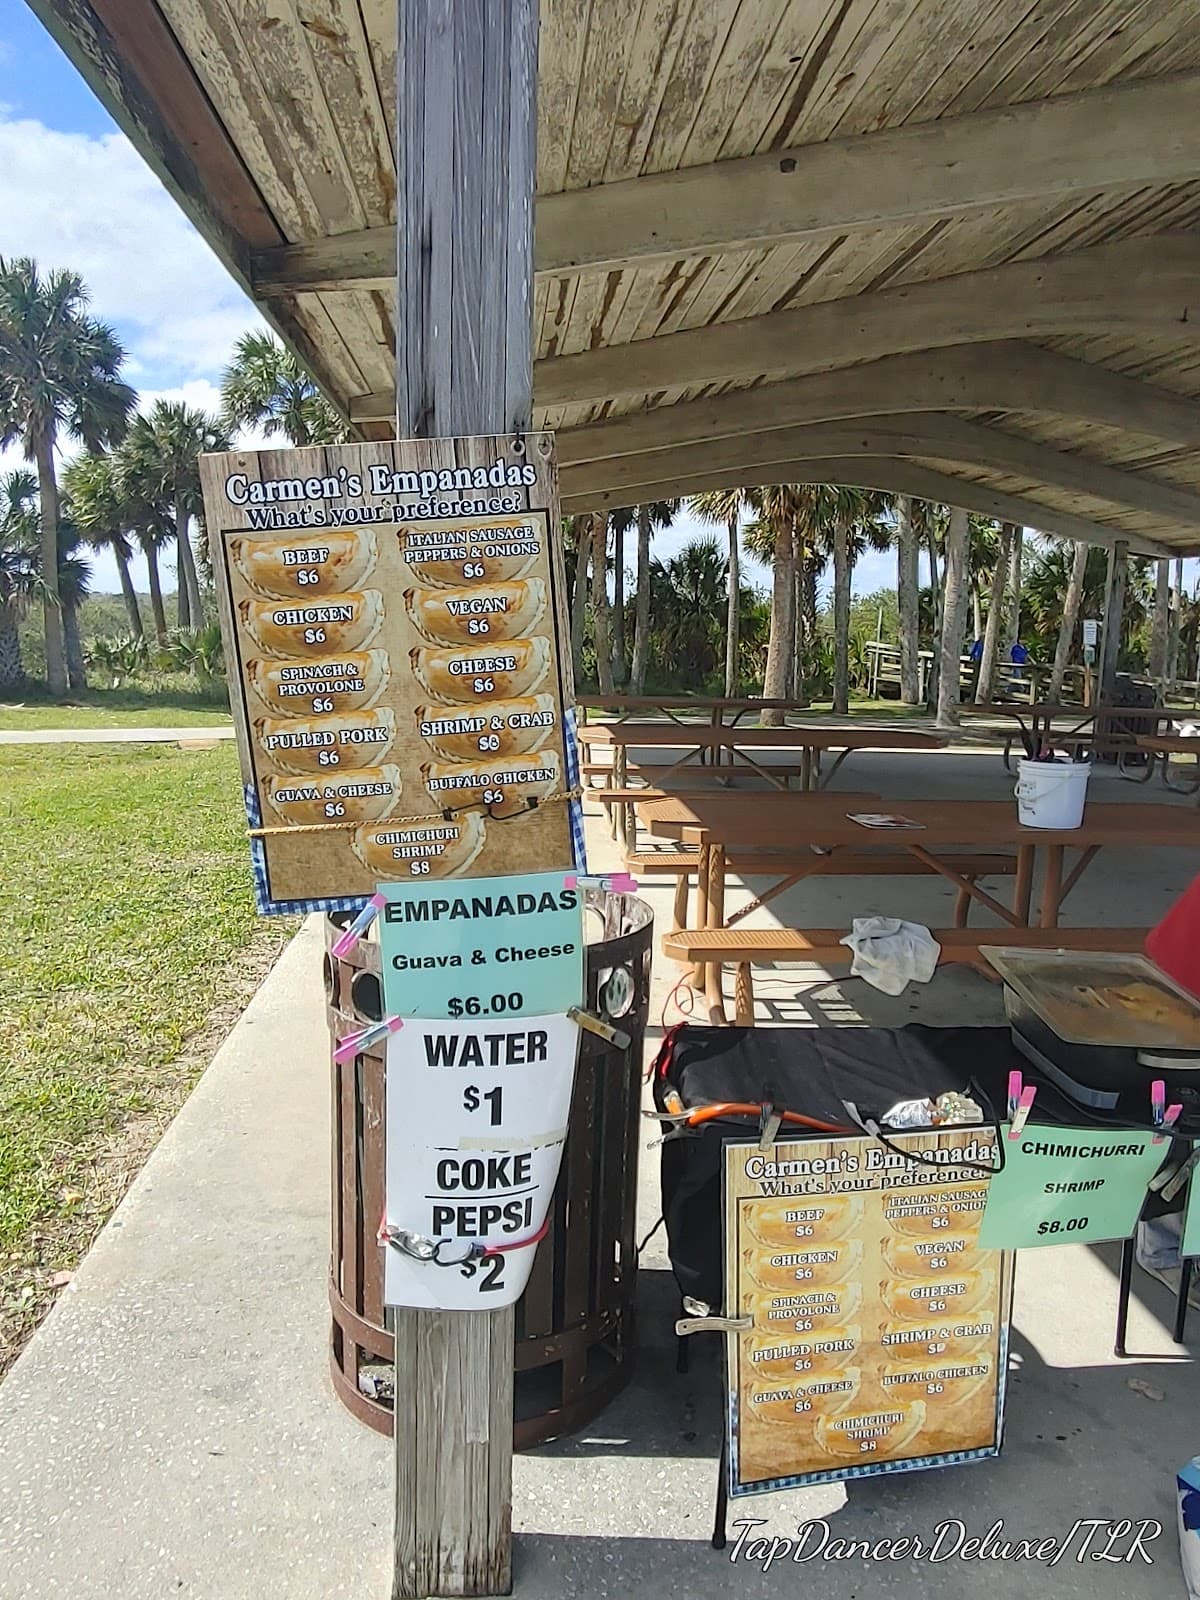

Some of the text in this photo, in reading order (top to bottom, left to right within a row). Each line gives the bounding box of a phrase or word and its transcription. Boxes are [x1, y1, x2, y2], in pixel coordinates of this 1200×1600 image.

[226, 458, 537, 506] Carmen's Empanadas
[245, 491, 522, 530] What's your preference?
[407, 526, 534, 547] ITALIAN SAUSAGE
[283, 549, 329, 566] BEEF
[404, 542, 539, 563] PEPPERS & ONIONS
[297, 570, 319, 586] $6
[463, 562, 484, 578] $6
[447, 597, 508, 615] VEGAN
[272, 606, 353, 626] CHICKEN
[468, 618, 489, 634] $6
[304, 628, 326, 644] $6
[281, 663, 358, 681] SPINACH &
[448, 657, 516, 675] CHEESE
[278, 678, 365, 696] PROVOLONE
[474, 678, 494, 693] $6
[312, 698, 333, 713] $6
[421, 711, 554, 736] SHRIMP & CRAB
[267, 727, 388, 750] PULLED PORK
[478, 735, 499, 751] $8
[318, 750, 340, 766] $6
[429, 768, 555, 791] BUFFALO CHICKEN
[275, 782, 392, 803] GUAVA & CHEESE
[483, 789, 504, 805] $6
[325, 802, 345, 817] $6
[376, 828, 459, 845] CHIMICHURI
[393, 844, 445, 859] SHRIMP
[410, 861, 430, 875] $8
[384, 890, 578, 923] EMPANADAS
[392, 944, 575, 970] Guava & Cheese
[448, 992, 523, 1017] $6.00
[423, 1030, 548, 1068] WATER
[463, 1086, 503, 1126] $1
[1021, 1141, 1145, 1159] CHIMICHURRI
[436, 1152, 531, 1191] COKE
[745, 1150, 858, 1180] Carmen's
[759, 1178, 824, 1197] What's
[830, 1178, 874, 1194] your
[1044, 1179, 1105, 1194] SHRIMP
[890, 1190, 987, 1207] ITALIAN SAUSAG
[433, 1197, 532, 1236] PEPSI
[786, 1209, 824, 1222] BEEF
[886, 1205, 936, 1218] PEPPERS
[940, 1203, 948, 1213] &
[796, 1226, 813, 1236] $6
[932, 1217, 948, 1228] $6
[1037, 1217, 1089, 1236] $8.00
[915, 1241, 965, 1255] VEGAN
[770, 1252, 837, 1266] CHICKEN
[930, 1257, 947, 1269] $6
[795, 1268, 813, 1279] $6
[772, 1293, 836, 1307] SPINACH &
[909, 1284, 966, 1299] CHEESE
[768, 1305, 840, 1319] PROVOLONE
[929, 1301, 946, 1312] $6
[795, 1320, 812, 1331] $6
[882, 1324, 992, 1345] SHRIMP & CRAB
[753, 1339, 854, 1362] PULLED PORK
[794, 1359, 811, 1371] $6
[883, 1365, 988, 1386] BUFFALO CHICKEN
[754, 1381, 853, 1402] GUAVA & CHEESE
[927, 1383, 943, 1394] $6
[795, 1401, 811, 1412] $6
[847, 1426, 890, 1440] SHRIMP
